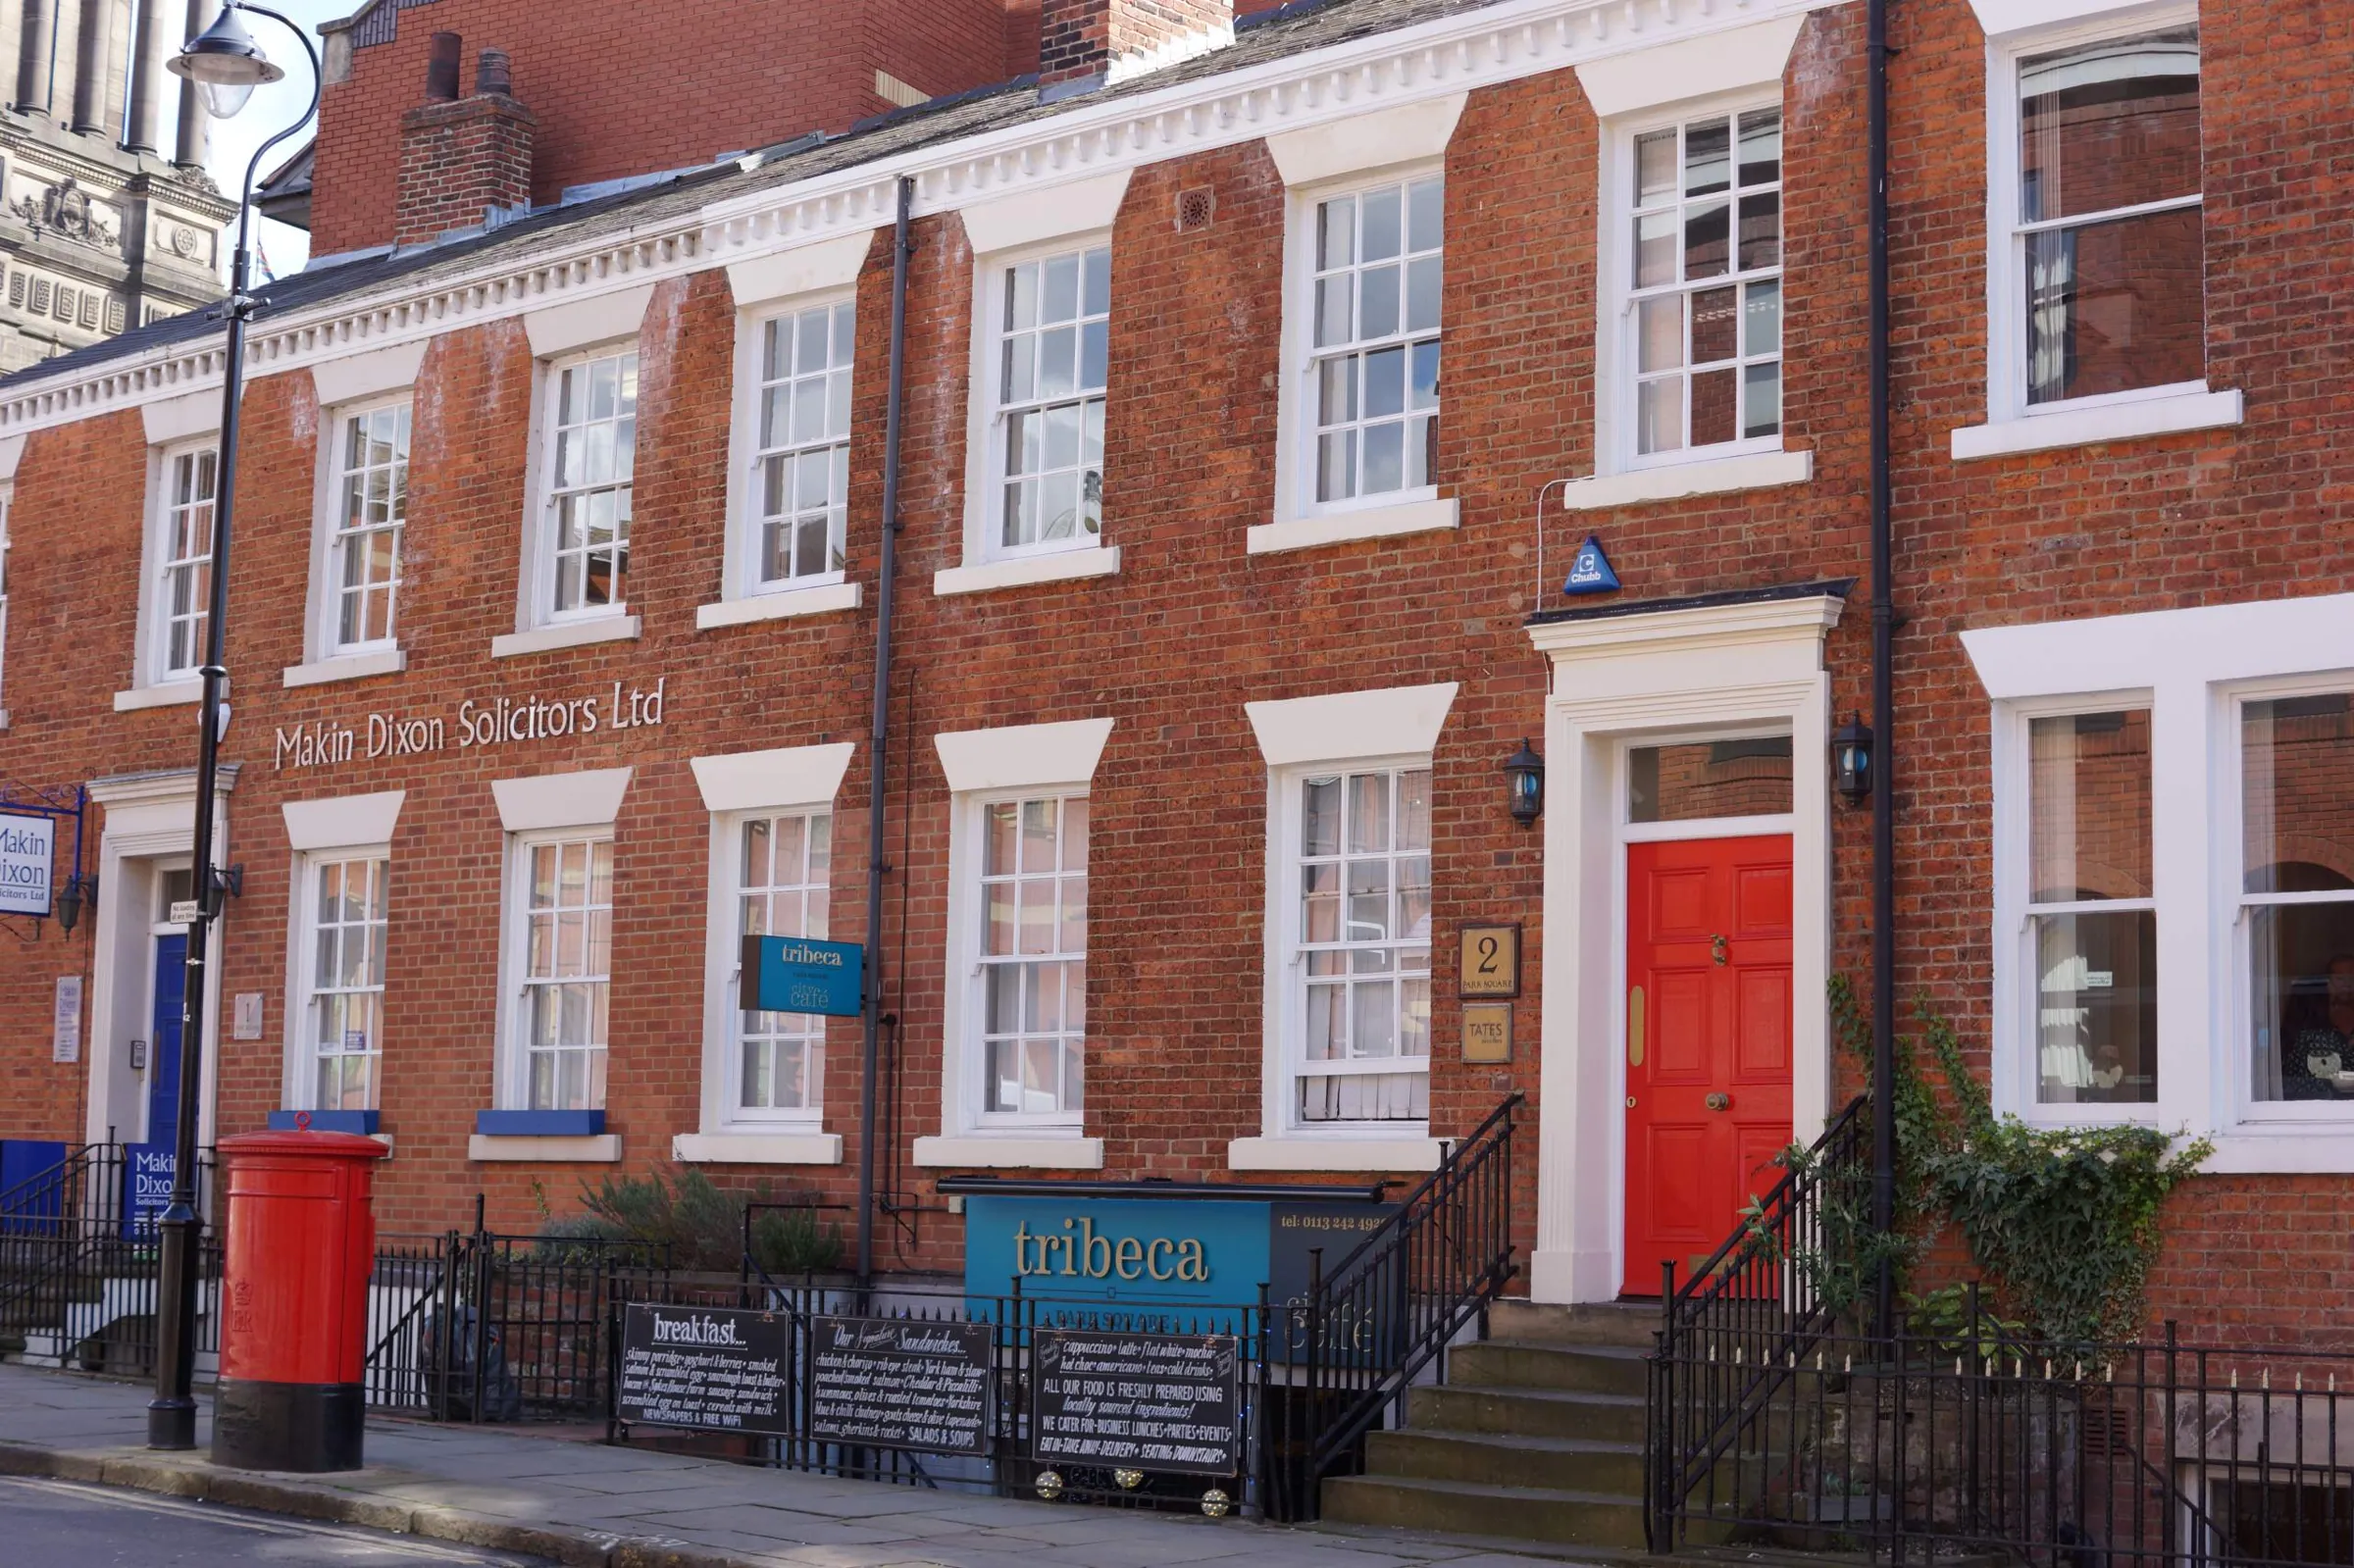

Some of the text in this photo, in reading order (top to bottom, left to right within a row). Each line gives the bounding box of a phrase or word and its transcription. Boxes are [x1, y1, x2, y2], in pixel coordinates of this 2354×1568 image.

[1571, 572, 1602, 583] Chubb
[275, 677, 665, 770] Makin Dixon Solicitors Ltd
[0, 858, 44, 885] ixon
[782, 944, 843, 966] tribeca
[1478, 936, 1498, 974] 2
[1468, 1023, 1503, 1037] TATES
[135, 1197, 170, 1206] Solicitors
[1281, 1215, 1301, 1228] tel:
[1303, 1216, 1330, 1230] 0113
[1332, 1217, 1355, 1230] 242
[1014, 1217, 1209, 1283] tribeca
[835, 1324, 854, 1346] Our
[626, 1346, 651, 1364] skinny
[747, 1358, 778, 1372] smoked
[1063, 1340, 1114, 1356] cappuccino
[1141, 1341, 1161, 1359] flat
[1159, 1342, 1182, 1357] white
[816, 1352, 843, 1367] chicken
[901, 1359, 922, 1373] steak
[925, 1359, 942, 1375] York
[941, 1361, 958, 1375] ham
[1060, 1355, 1075, 1370] hot
[1096, 1359, 1144, 1373] americano
[1166, 1360, 1185, 1376] cold
[872, 1372, 899, 1388] salmon
[903, 1375, 937, 1390] Cheddar
[1044, 1378, 1223, 1402] ALL OUR FOOD IS FRESHLY PREPARED USING
[622, 1393, 659, 1406] scrambled
[706, 1400, 736, 1412] cereals
[753, 1403, 773, 1416] milk
[737, 1388, 772, 1400] sandwich
[853, 1388, 877, 1401] olives
[877, 1390, 884, 1402] &
[884, 1391, 912, 1404] roasted
[911, 1392, 946, 1408] tomatoes
[947, 1394, 982, 1410] Yorkshire
[642, 1408, 692, 1422] NEWSPAPERS
[694, 1412, 699, 1423] &
[702, 1413, 720, 1425] FREE
[854, 1405, 882, 1422] chutney
[902, 1408, 923, 1422] cheese
[1062, 1395, 1197, 1419] locally sourced ingredients!
[841, 1421, 874, 1437] gherkins
[908, 1427, 940, 1443] SALADS
[941, 1430, 947, 1443] &
[948, 1431, 975, 1447] SOUPS
[1043, 1415, 1055, 1431] WE
[1058, 1416, 1080, 1432] CATER
[1132, 1421, 1164, 1438] LUNCHES
[1040, 1437, 1054, 1451] EAT
[1140, 1443, 1173, 1460] SEATING
